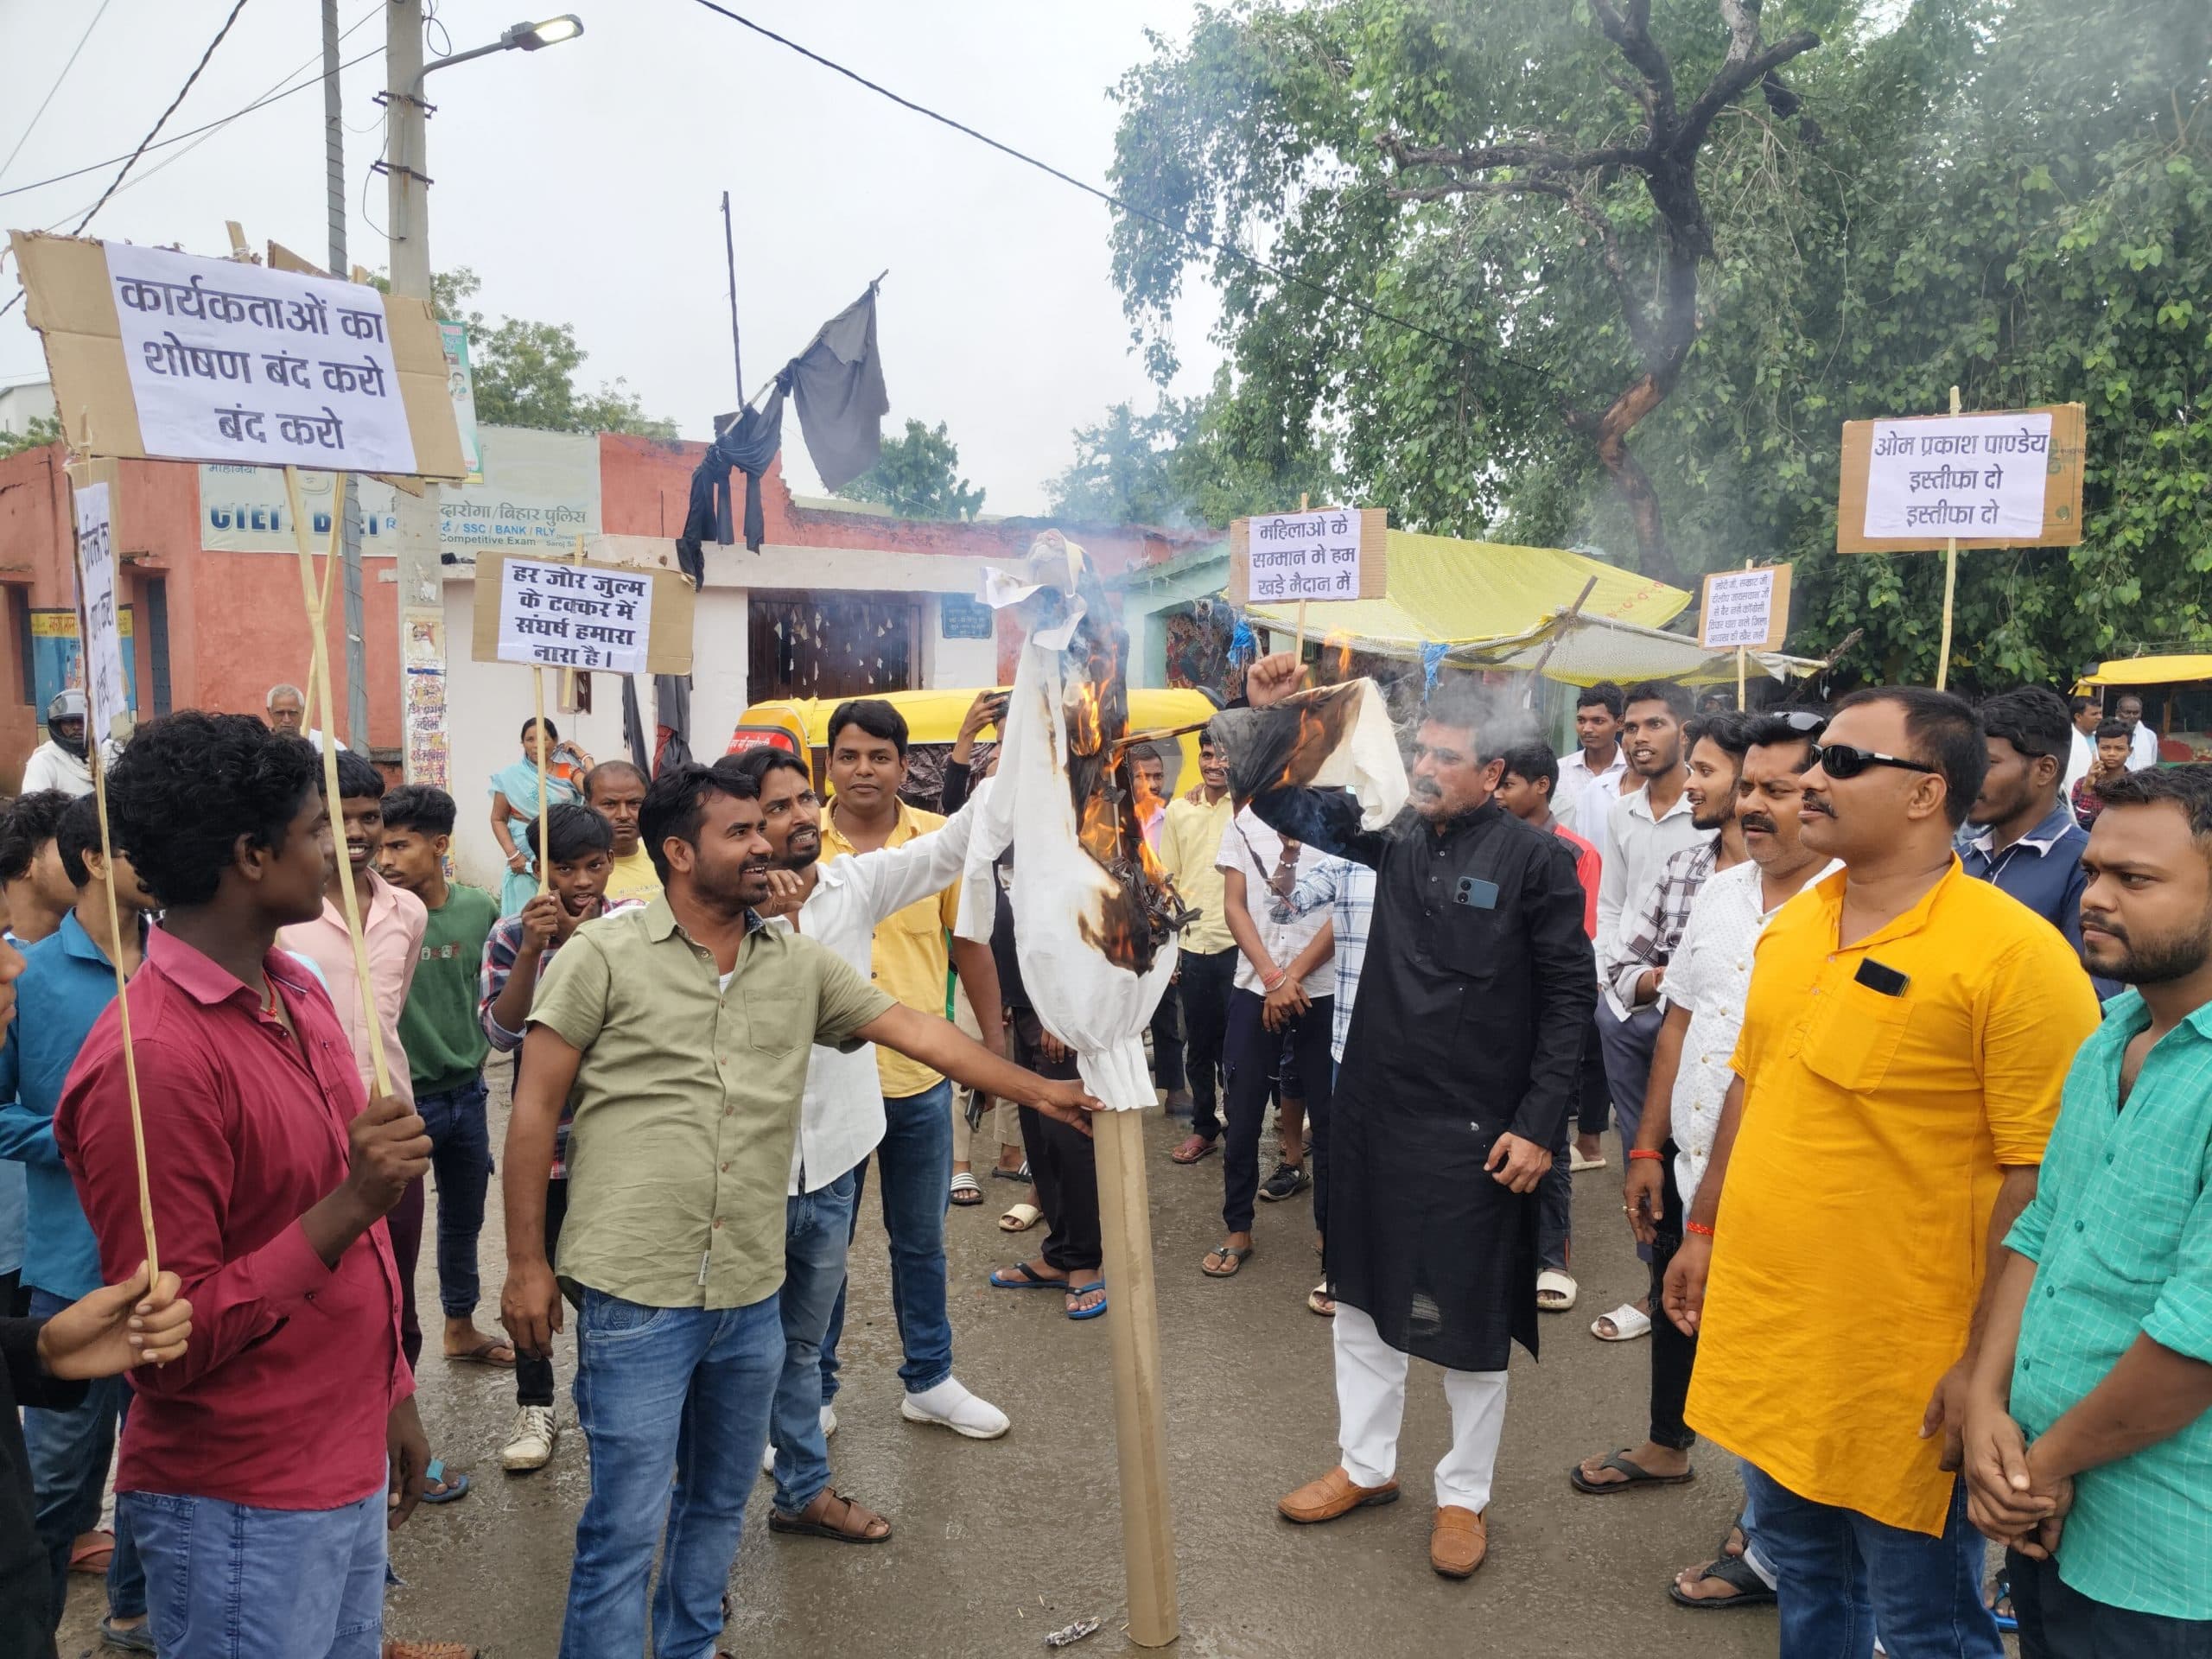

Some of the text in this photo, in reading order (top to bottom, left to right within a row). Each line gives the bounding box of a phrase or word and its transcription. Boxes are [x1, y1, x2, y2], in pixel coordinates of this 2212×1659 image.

[337, 307, 385, 344] का
[143, 331, 386, 397] शोषण बंद करो
[214, 402, 346, 449] बंद करो
[1874, 428, 2049, 457] ओम प्रकाश पाण्डेय
[1909, 463, 2004, 493] इस्तीफा दो
[545, 505, 586, 527] पुलिस
[1331, 514, 1348, 535] के
[1906, 499, 2000, 528] इस्तीफा दो
[440, 534, 536, 546] Competitive Exam
[463, 522, 486, 533] SSC
[495, 525, 526, 536] BANK
[536, 527, 556, 536] RLY
[1253, 550, 1306, 569] सम्मान
[1330, 547, 1356, 563] हम
[512, 565, 646, 598] हर जोर जुल्म
[1258, 570, 1351, 598] खड़े मैदान में
[518, 588, 638, 621] के टक्कर में
[515, 613, 636, 645] संघर्ष हमारा
[533, 644, 578, 664] नारा
